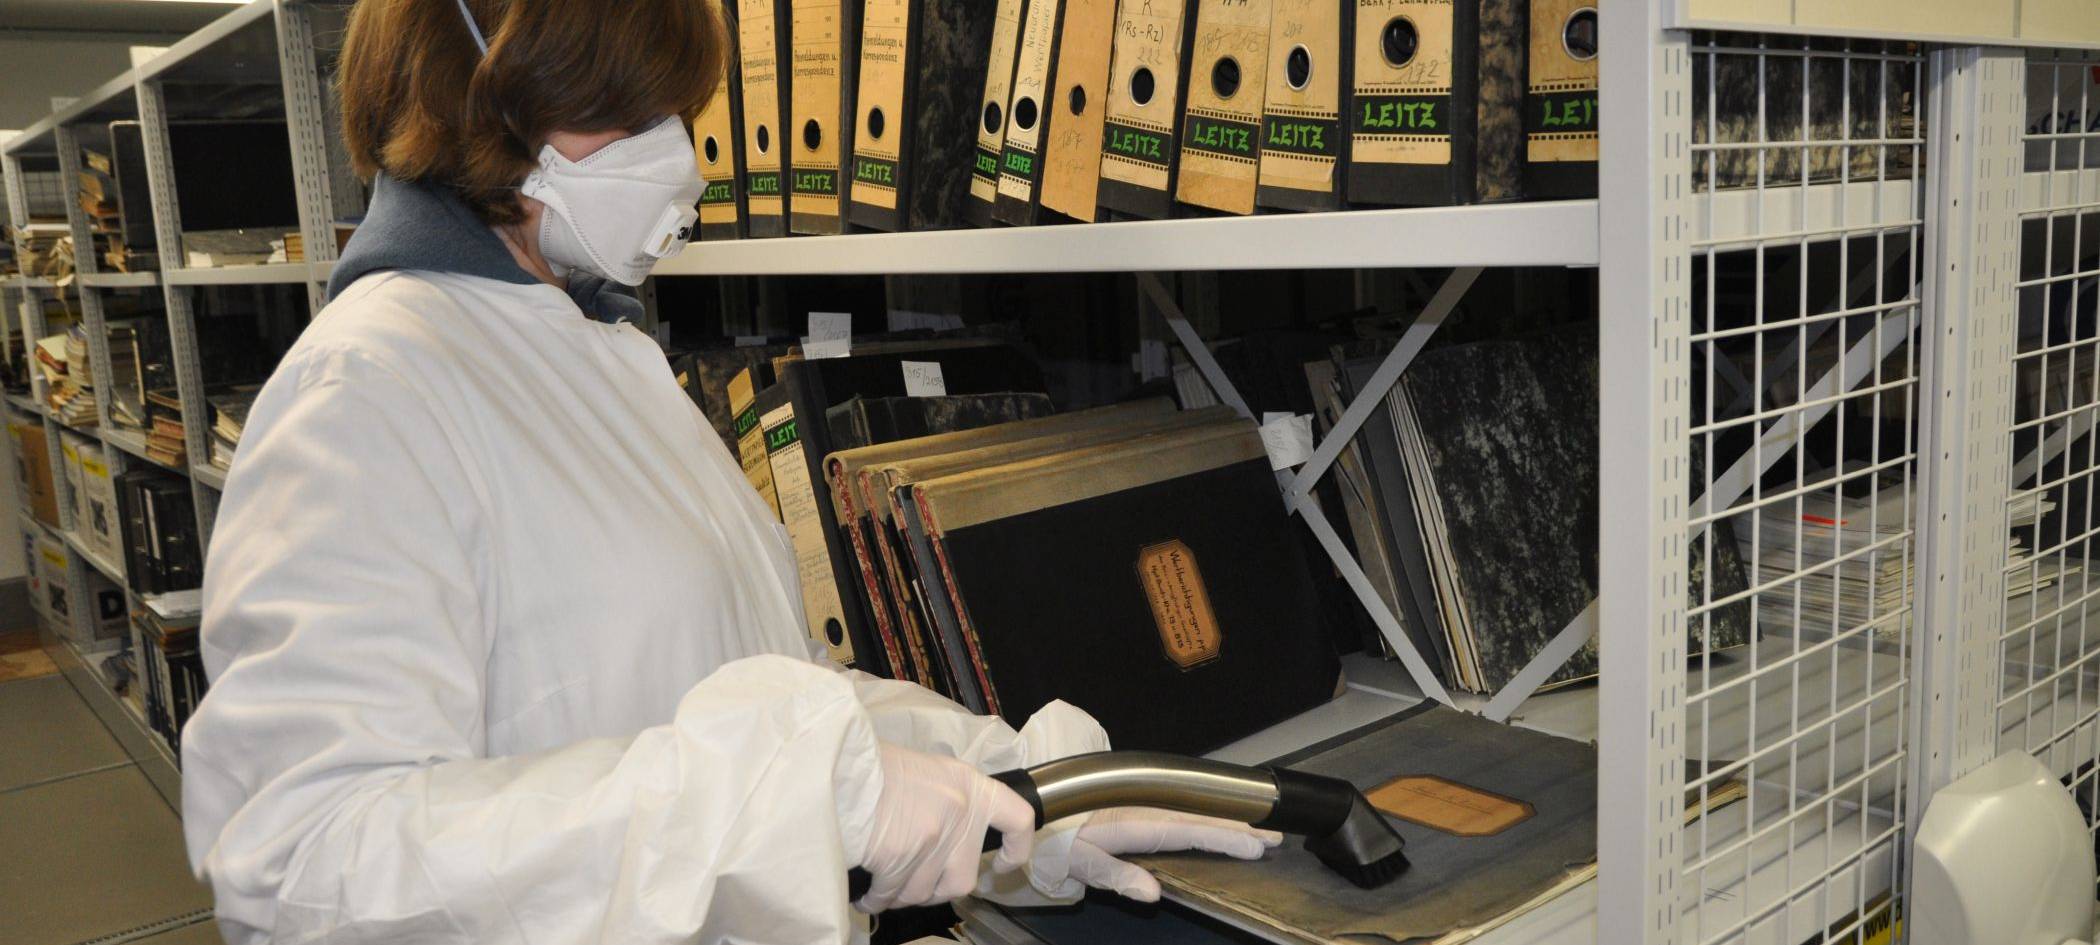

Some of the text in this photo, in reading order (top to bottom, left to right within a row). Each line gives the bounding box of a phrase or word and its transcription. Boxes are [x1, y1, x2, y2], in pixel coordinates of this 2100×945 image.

[1362, 101, 1437, 128] LEITZ
[1543, 99, 1598, 127] LEIT
[1111, 129, 1162, 159] LEITZ
[1193, 122, 1249, 152] LEITZ
[1269, 120, 1325, 150] LEITZ
[857, 159, 892, 183] LEITZ
[976, 153, 997, 175] LEITZ
[1005, 152, 1032, 175] LEITZ
[752, 175, 779, 192] LEITZ
[796, 172, 832, 191] LEITZ
[737, 407, 759, 433] LEITZ
